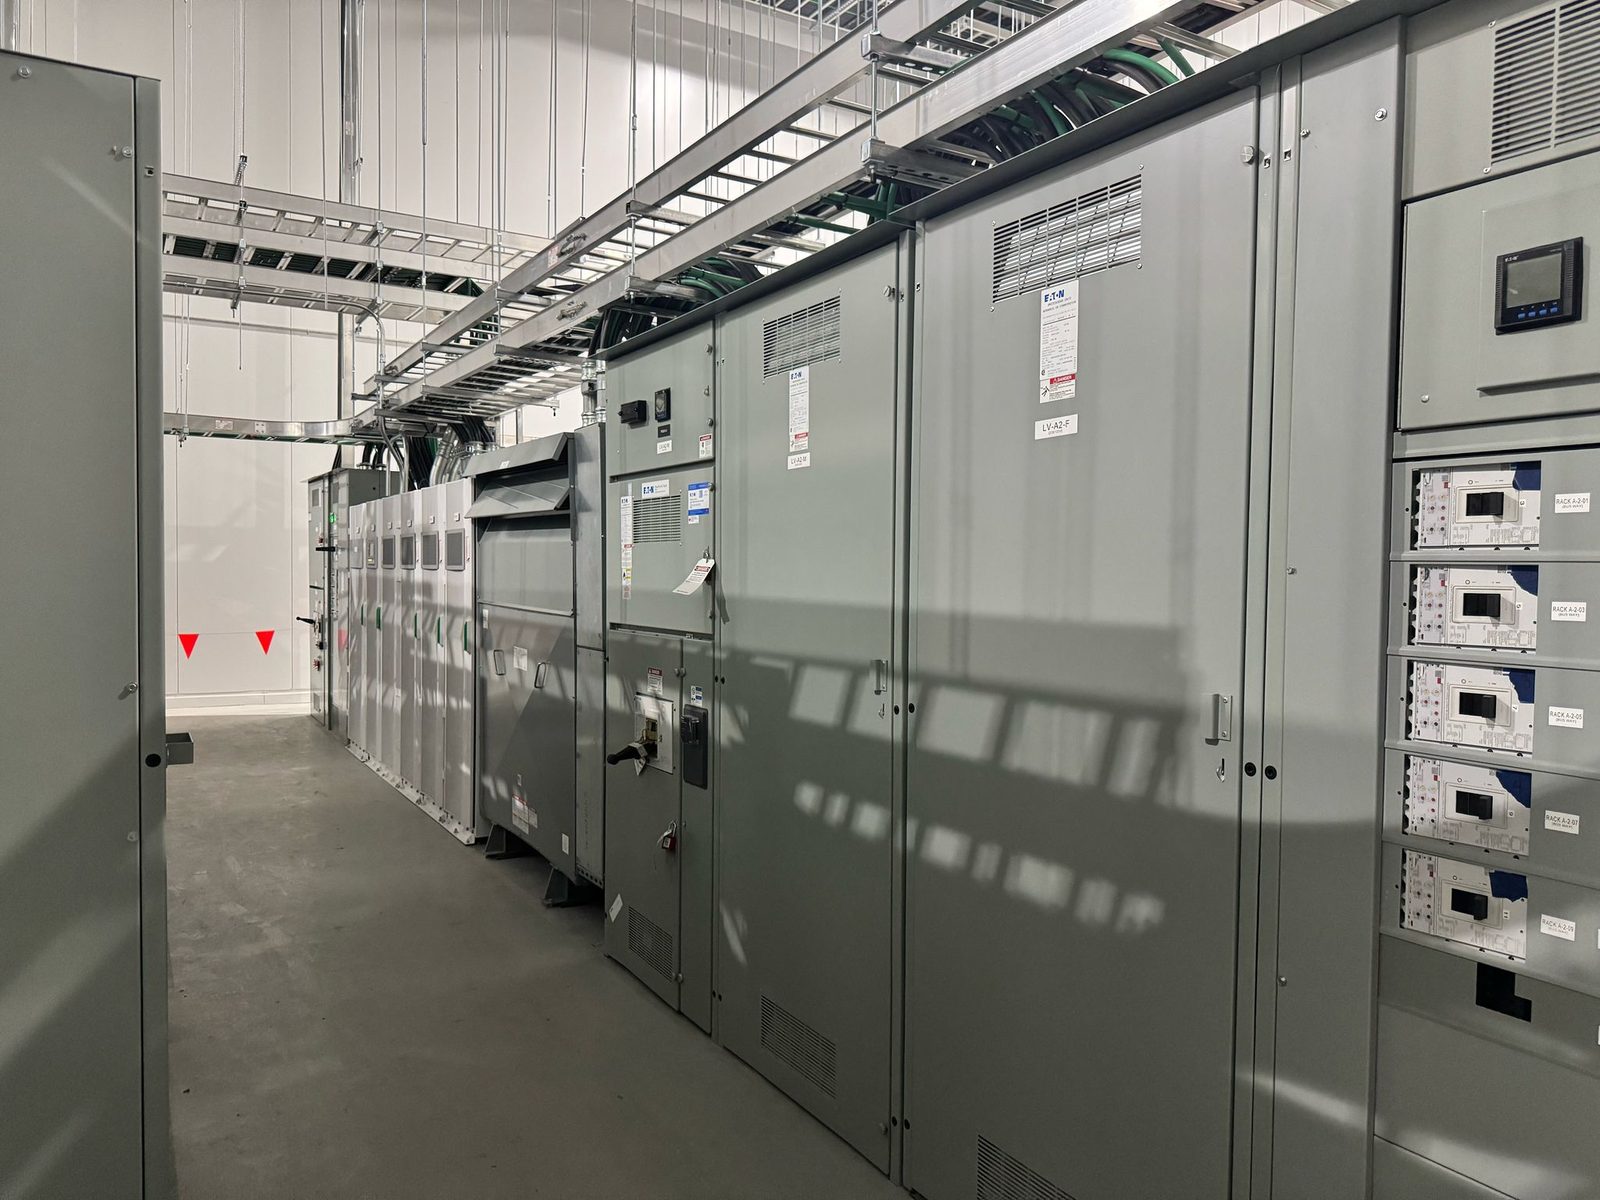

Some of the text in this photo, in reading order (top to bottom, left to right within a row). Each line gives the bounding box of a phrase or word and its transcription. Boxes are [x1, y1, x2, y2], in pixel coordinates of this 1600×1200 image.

[1042, 419, 1070, 432] LV-A2-F
[1549, 710, 1565, 718] RACK
[1545, 814, 1561, 823] RACK
